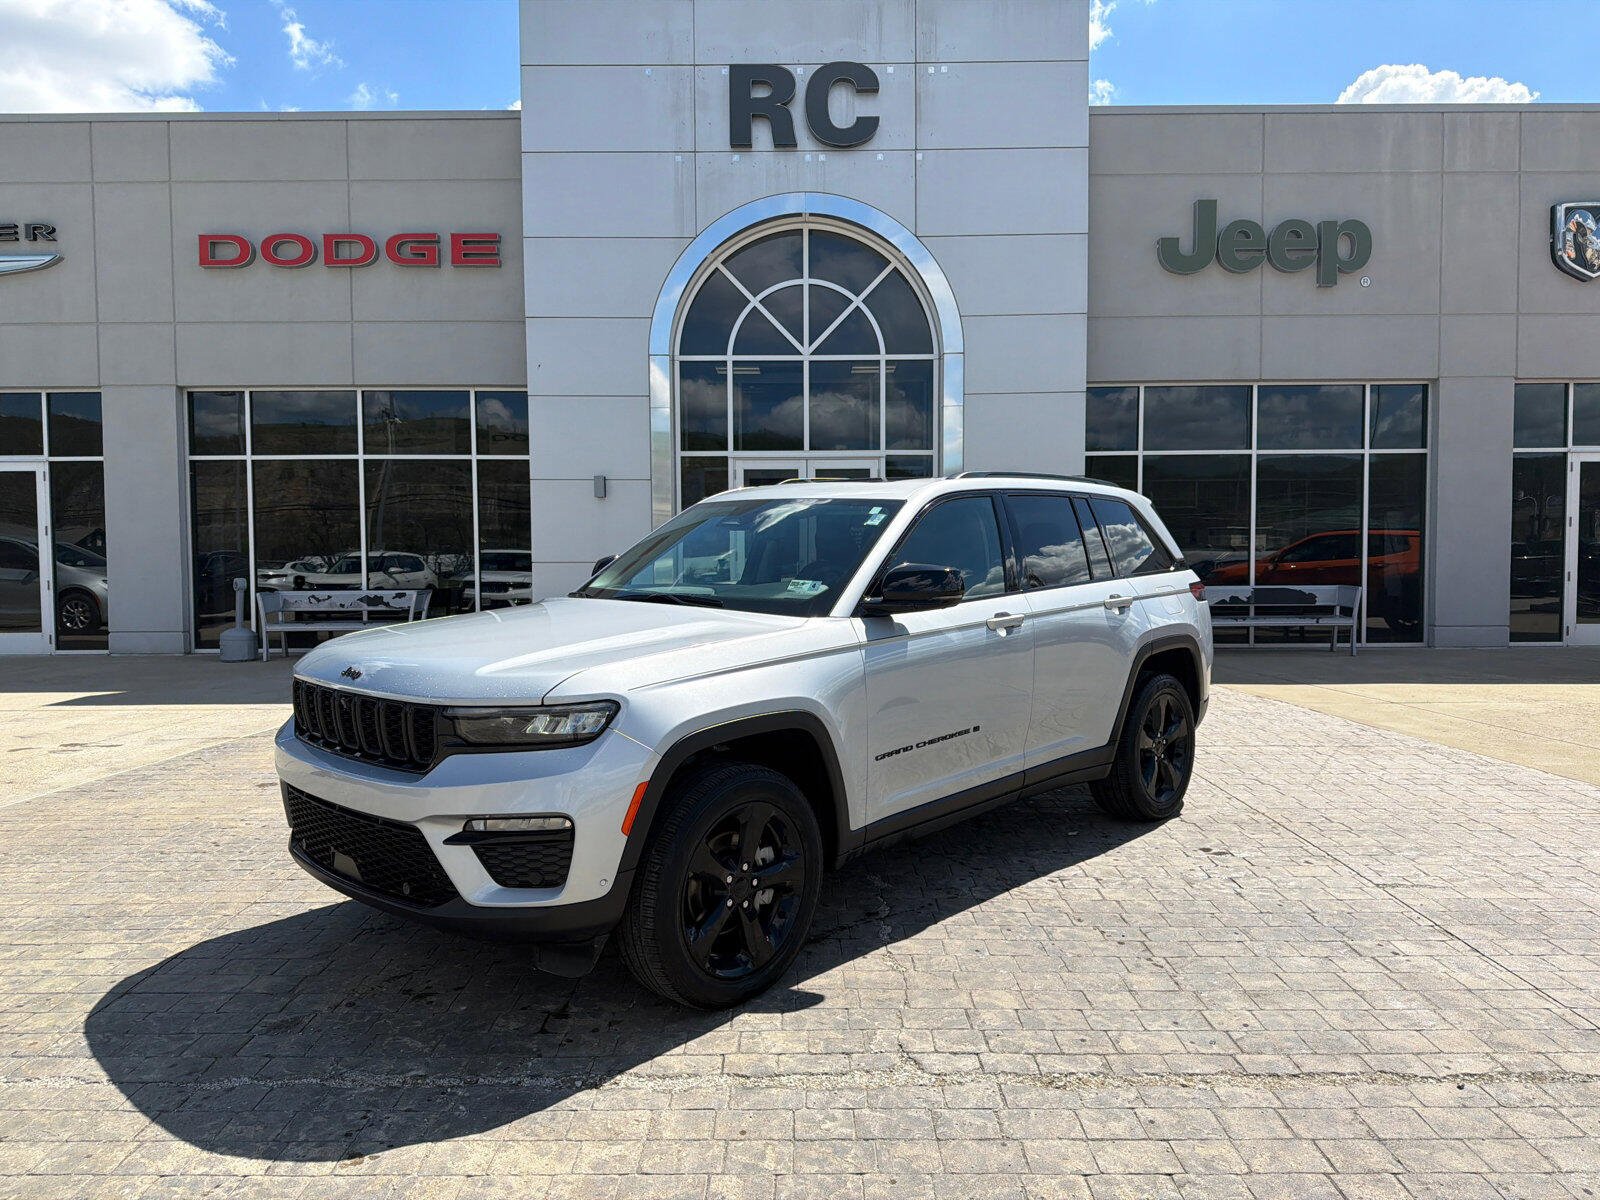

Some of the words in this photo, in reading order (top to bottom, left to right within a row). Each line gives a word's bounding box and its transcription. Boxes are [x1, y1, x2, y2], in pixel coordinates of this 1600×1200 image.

[729, 61, 880, 148] RC
[199, 233, 502, 268] DODGE
[1157, 199, 1373, 288] Jeep
[875, 745, 914, 761] GRAND
[916, 728, 971, 749] CHEROKEE
